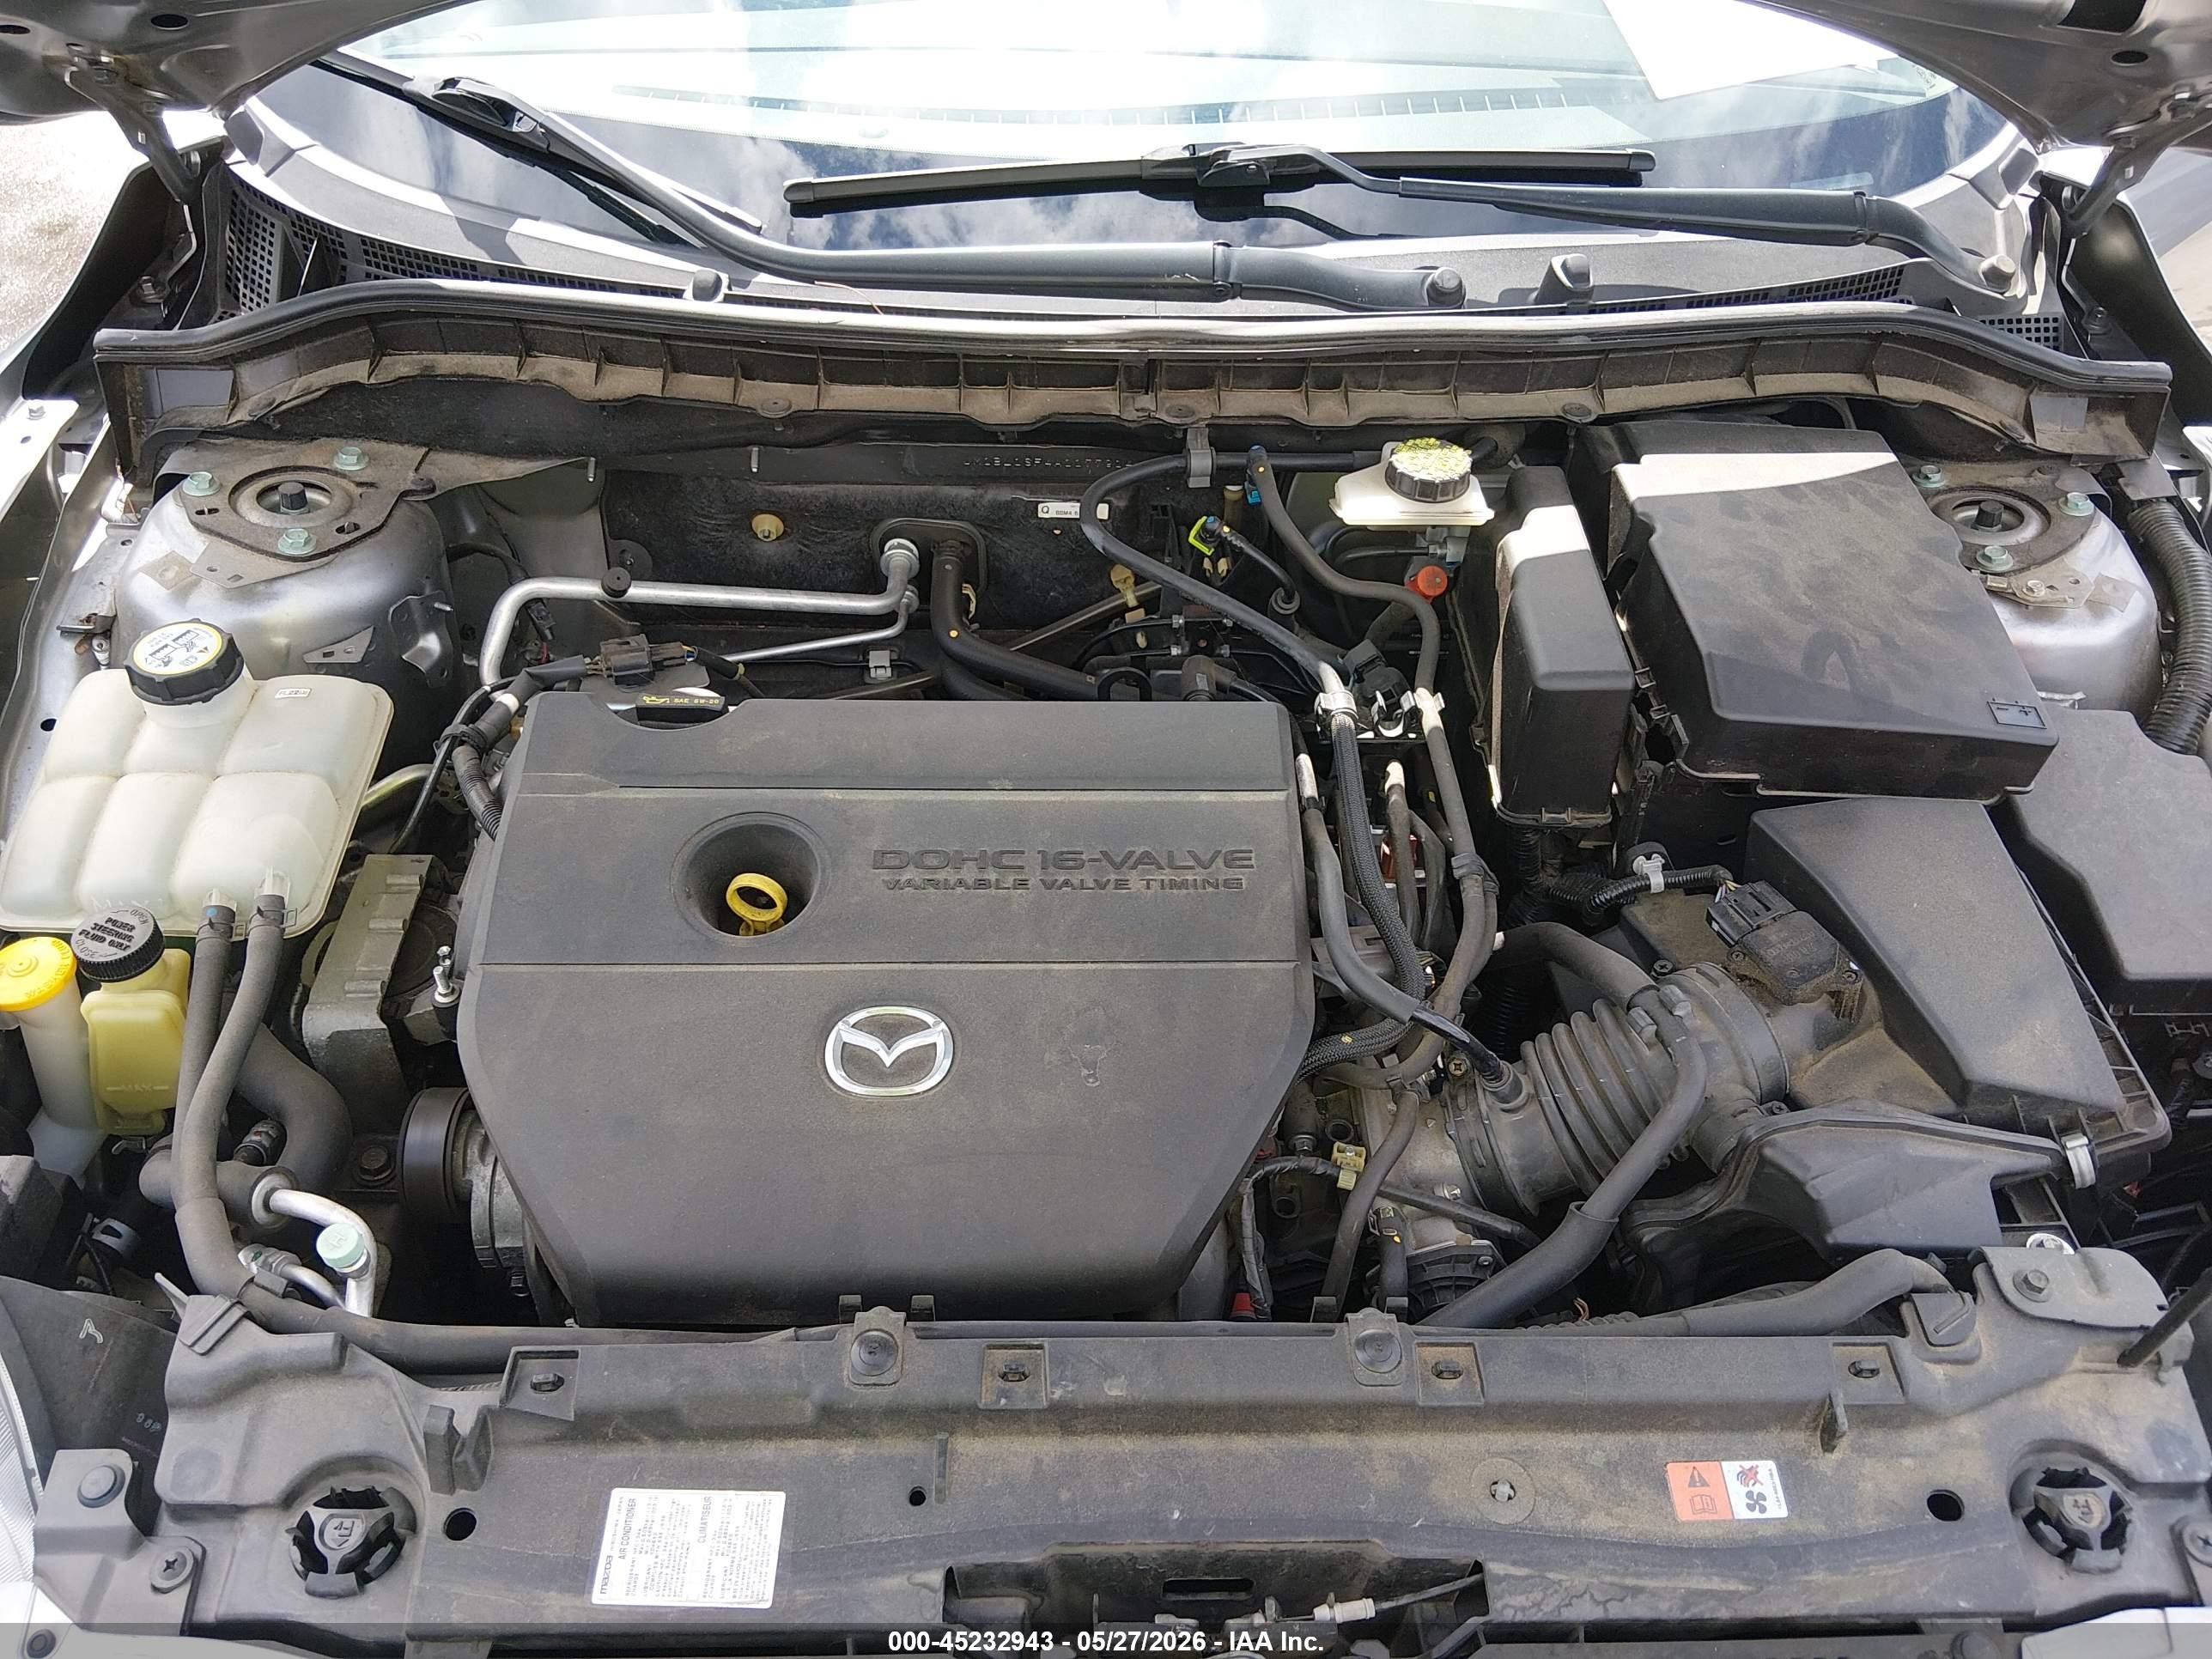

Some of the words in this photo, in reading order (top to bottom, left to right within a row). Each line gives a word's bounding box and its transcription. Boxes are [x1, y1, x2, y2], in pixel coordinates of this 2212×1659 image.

[872, 849, 1026, 871] DOHC
[1036, 848, 1255, 871] 16-VALVE
[883, 877, 1030, 891] VARIABLE
[1040, 877, 1131, 891] VALVE
[1142, 877, 1245, 890] TIMING
[104, 916, 137, 933] POWER
[131, 908, 149, 925] OPEN
[78, 928, 106, 944] FLUID
[107, 939, 131, 951] ONLY
[90, 922, 135, 943] STEERING
[76, 939, 99, 957] CLOSE
[620, 1498, 636, 1546] CONDITIONER
[697, 1496, 712, 1543] CLIMATISEUR
[599, 1555, 613, 1595] mazda
